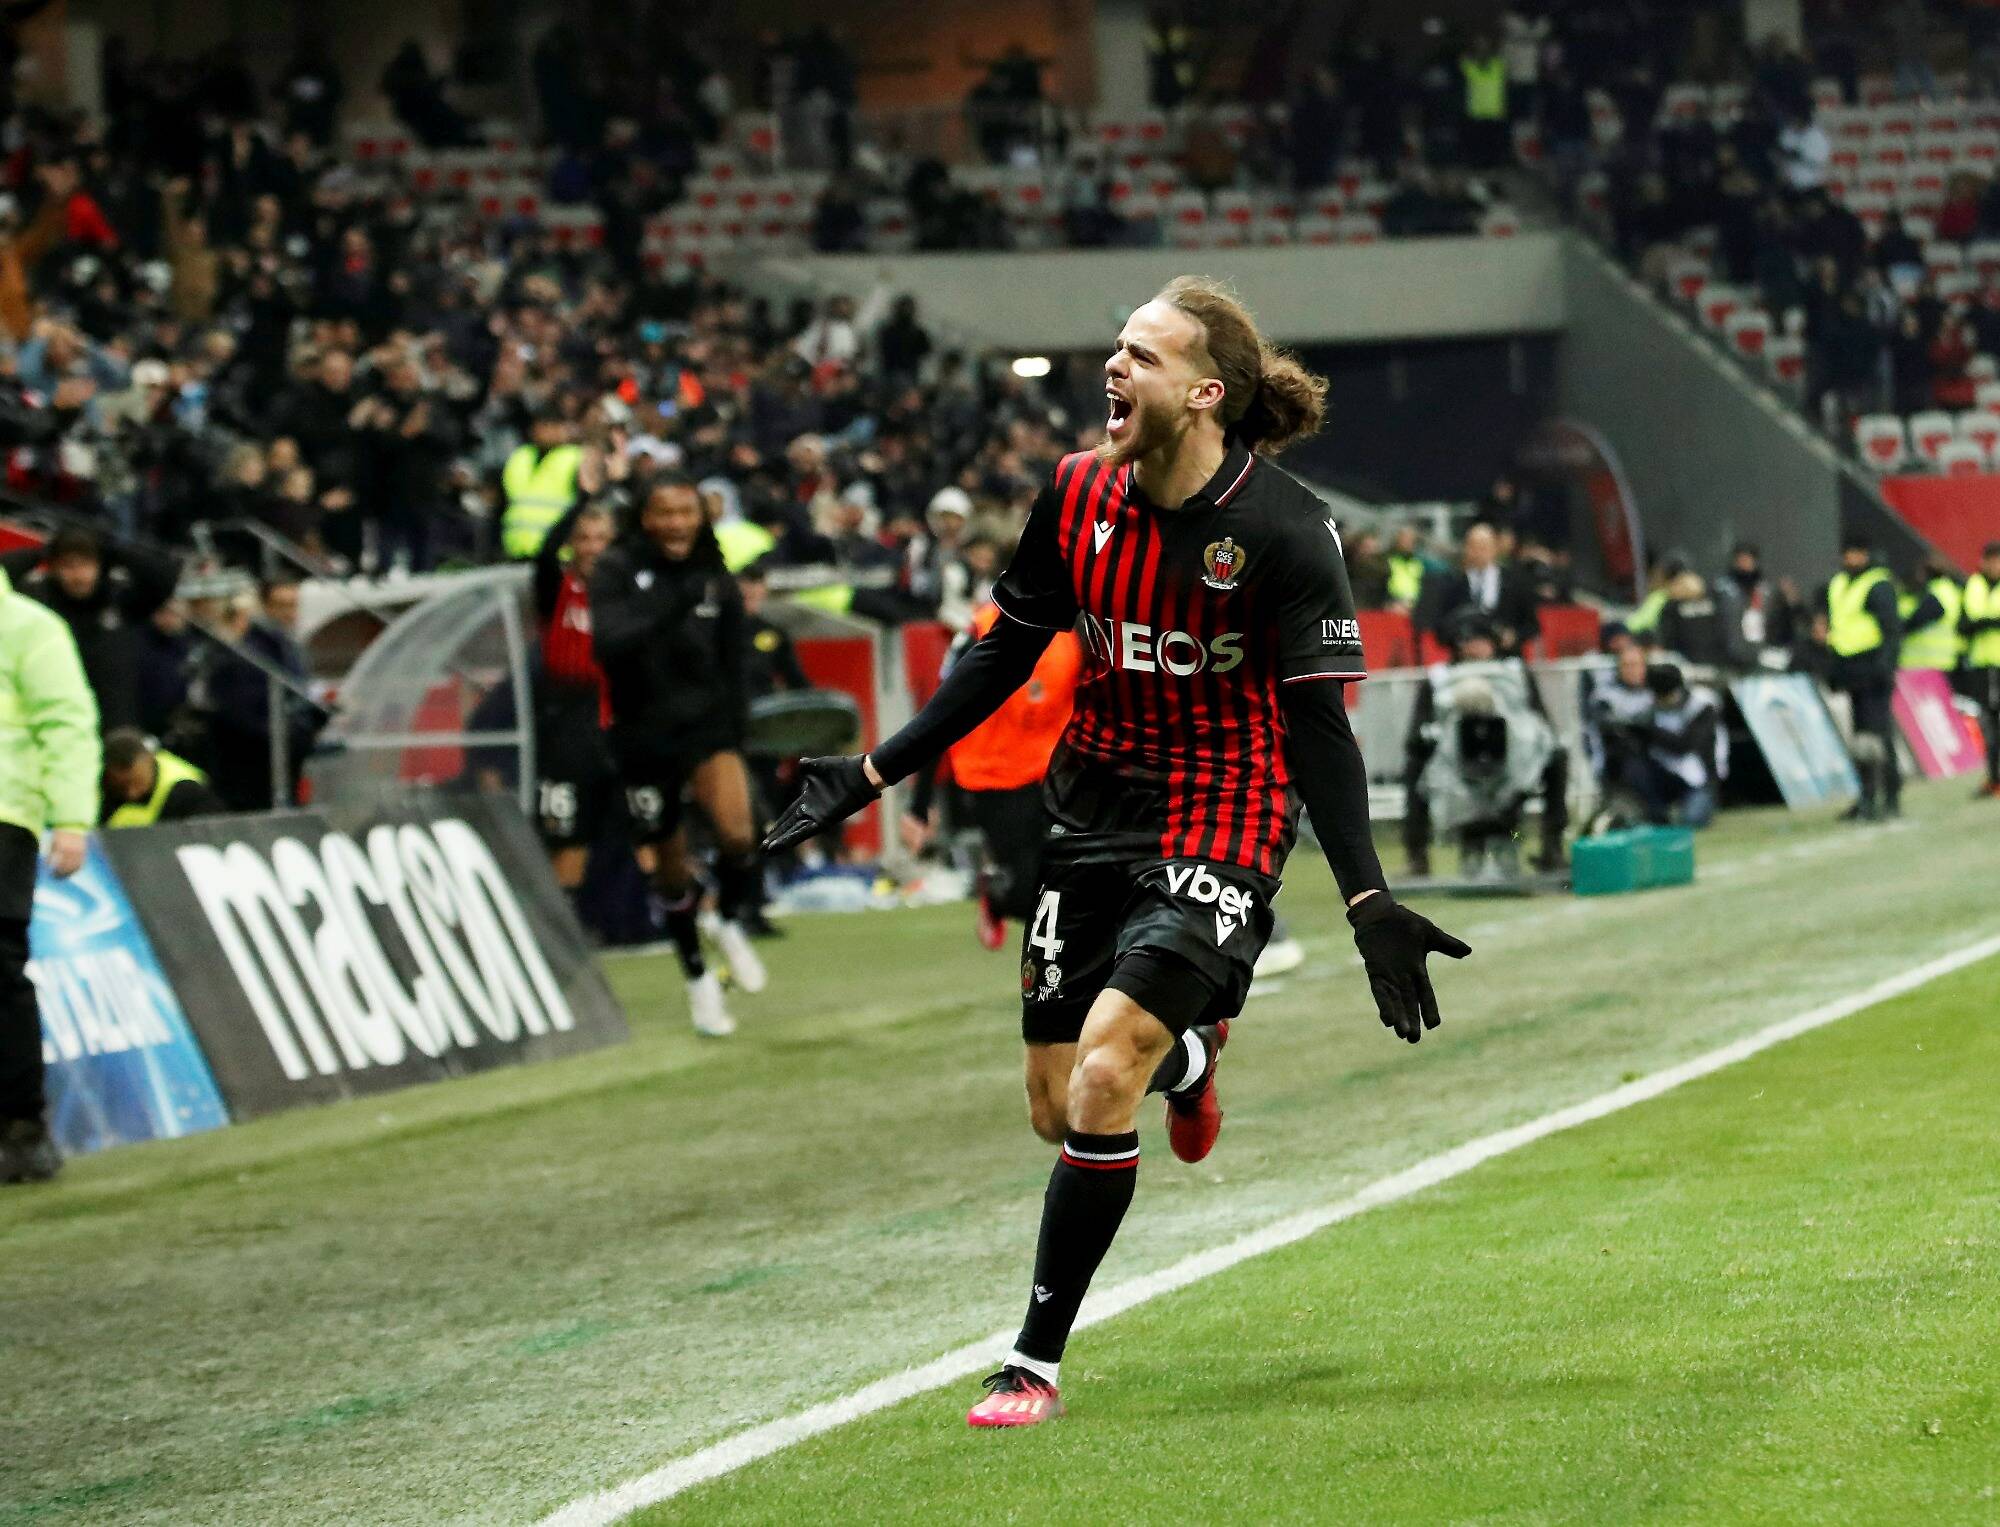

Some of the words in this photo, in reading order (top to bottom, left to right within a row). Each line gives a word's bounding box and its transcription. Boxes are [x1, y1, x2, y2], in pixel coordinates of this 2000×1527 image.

[1215, 556, 1232, 565] NICE
[1216, 550, 1234, 560] OGC
[1321, 619, 1361, 639] INEO
[539, 782, 577, 819] 16
[1165, 864, 1254, 927] vbet
[1028, 884, 1064, 961] 4
[177, 818, 575, 1081] macron
